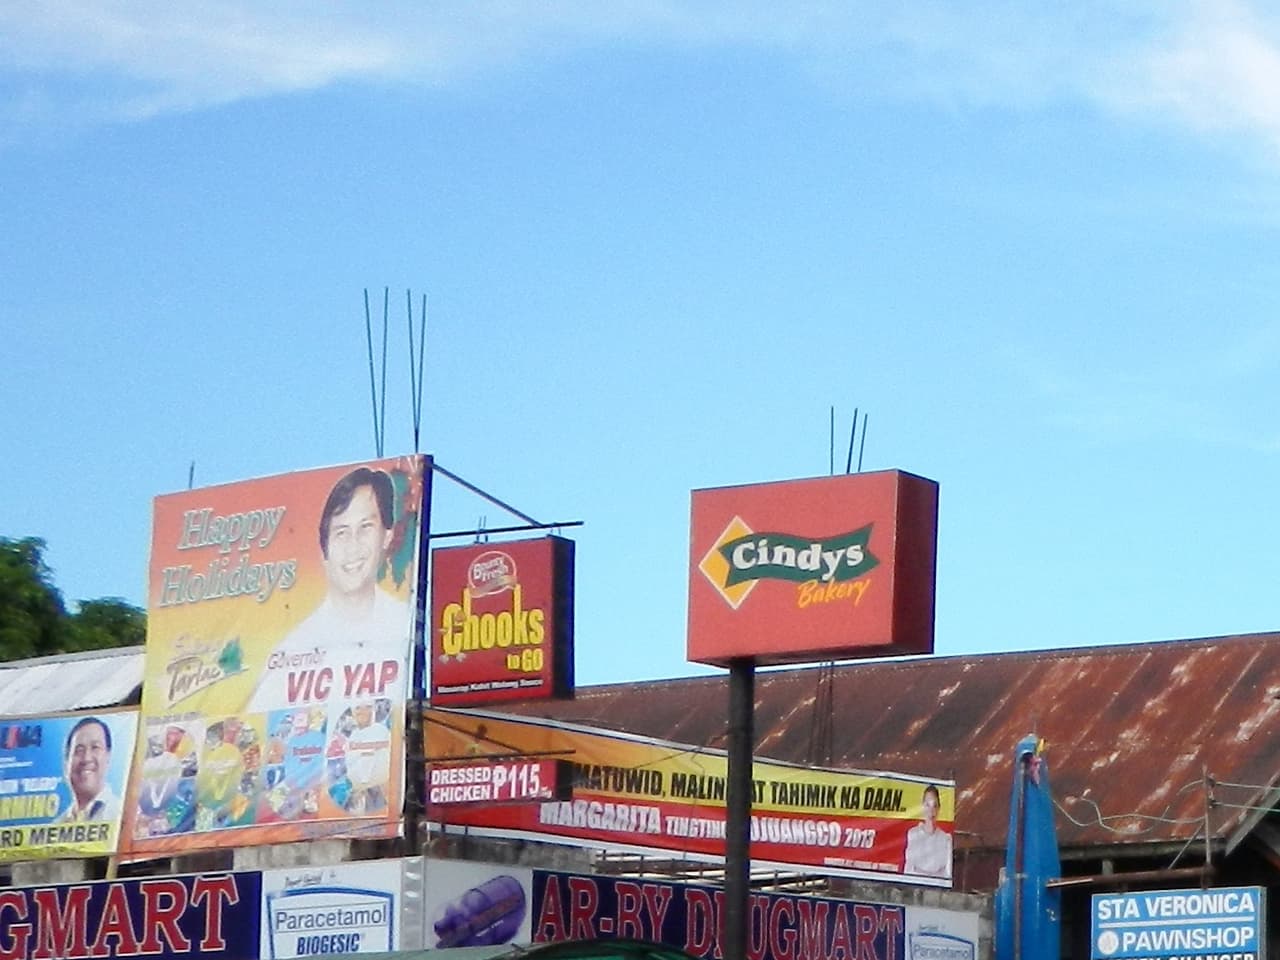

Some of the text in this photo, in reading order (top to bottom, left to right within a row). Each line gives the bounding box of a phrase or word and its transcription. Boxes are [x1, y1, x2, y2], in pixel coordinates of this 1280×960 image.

[177, 506, 287, 554] Happy
[732, 539, 865, 581] Cindys
[157, 554, 298, 608] Holidays
[797, 579, 872, 609] Bakery
[442, 583, 546, 656] Chooks
[267, 648, 328, 670] Governor
[521, 648, 544, 672] GO
[286, 659, 400, 704] VIC YAP
[431, 766, 491, 785] DRESSED
[430, 785, 491, 804] CHICKEN
[671, 772, 726, 801] MALIN
[769, 780, 836, 811] TAHIMIK
[841, 786, 861, 812] NA
[0, 824, 110, 846] RD MEMBER
[540, 800, 662, 835] MARGARITA
[751, 815, 842, 848] OJUANGCO
[843, 827, 877, 850] 2013
[275, 904, 388, 931] Paracetamol
[534, 875, 674, 944] AR-BY
[1098, 892, 1255, 920] STA VERONICA
[296, 933, 361, 956] BIOGESIC
[1122, 926, 1255, 952] PAWNSHOP
